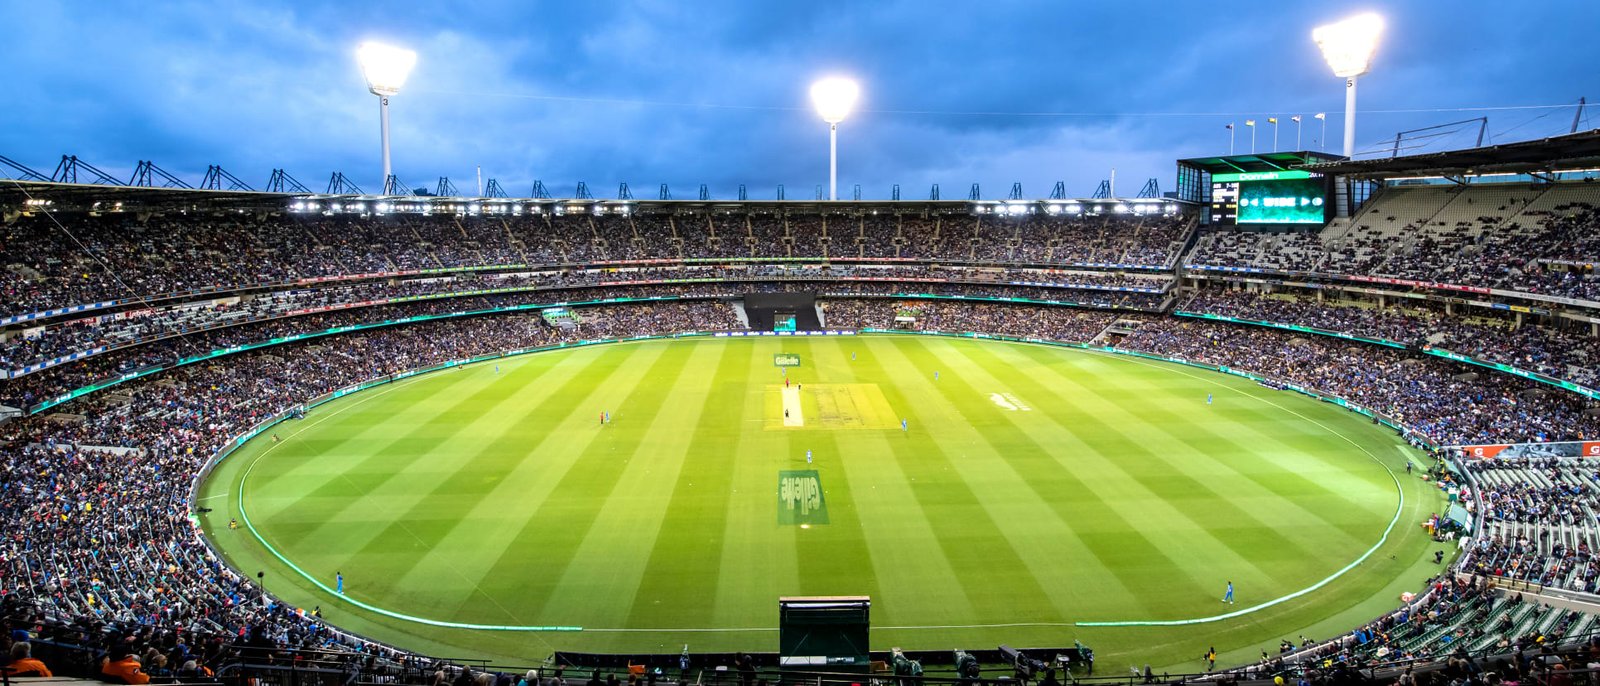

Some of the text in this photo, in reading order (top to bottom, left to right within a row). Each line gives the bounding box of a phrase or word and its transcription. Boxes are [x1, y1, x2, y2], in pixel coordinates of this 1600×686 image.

[382, 98, 389, 106] 3
[1239, 172, 1279, 181] Domain
[781, 477, 821, 515] Gillette
